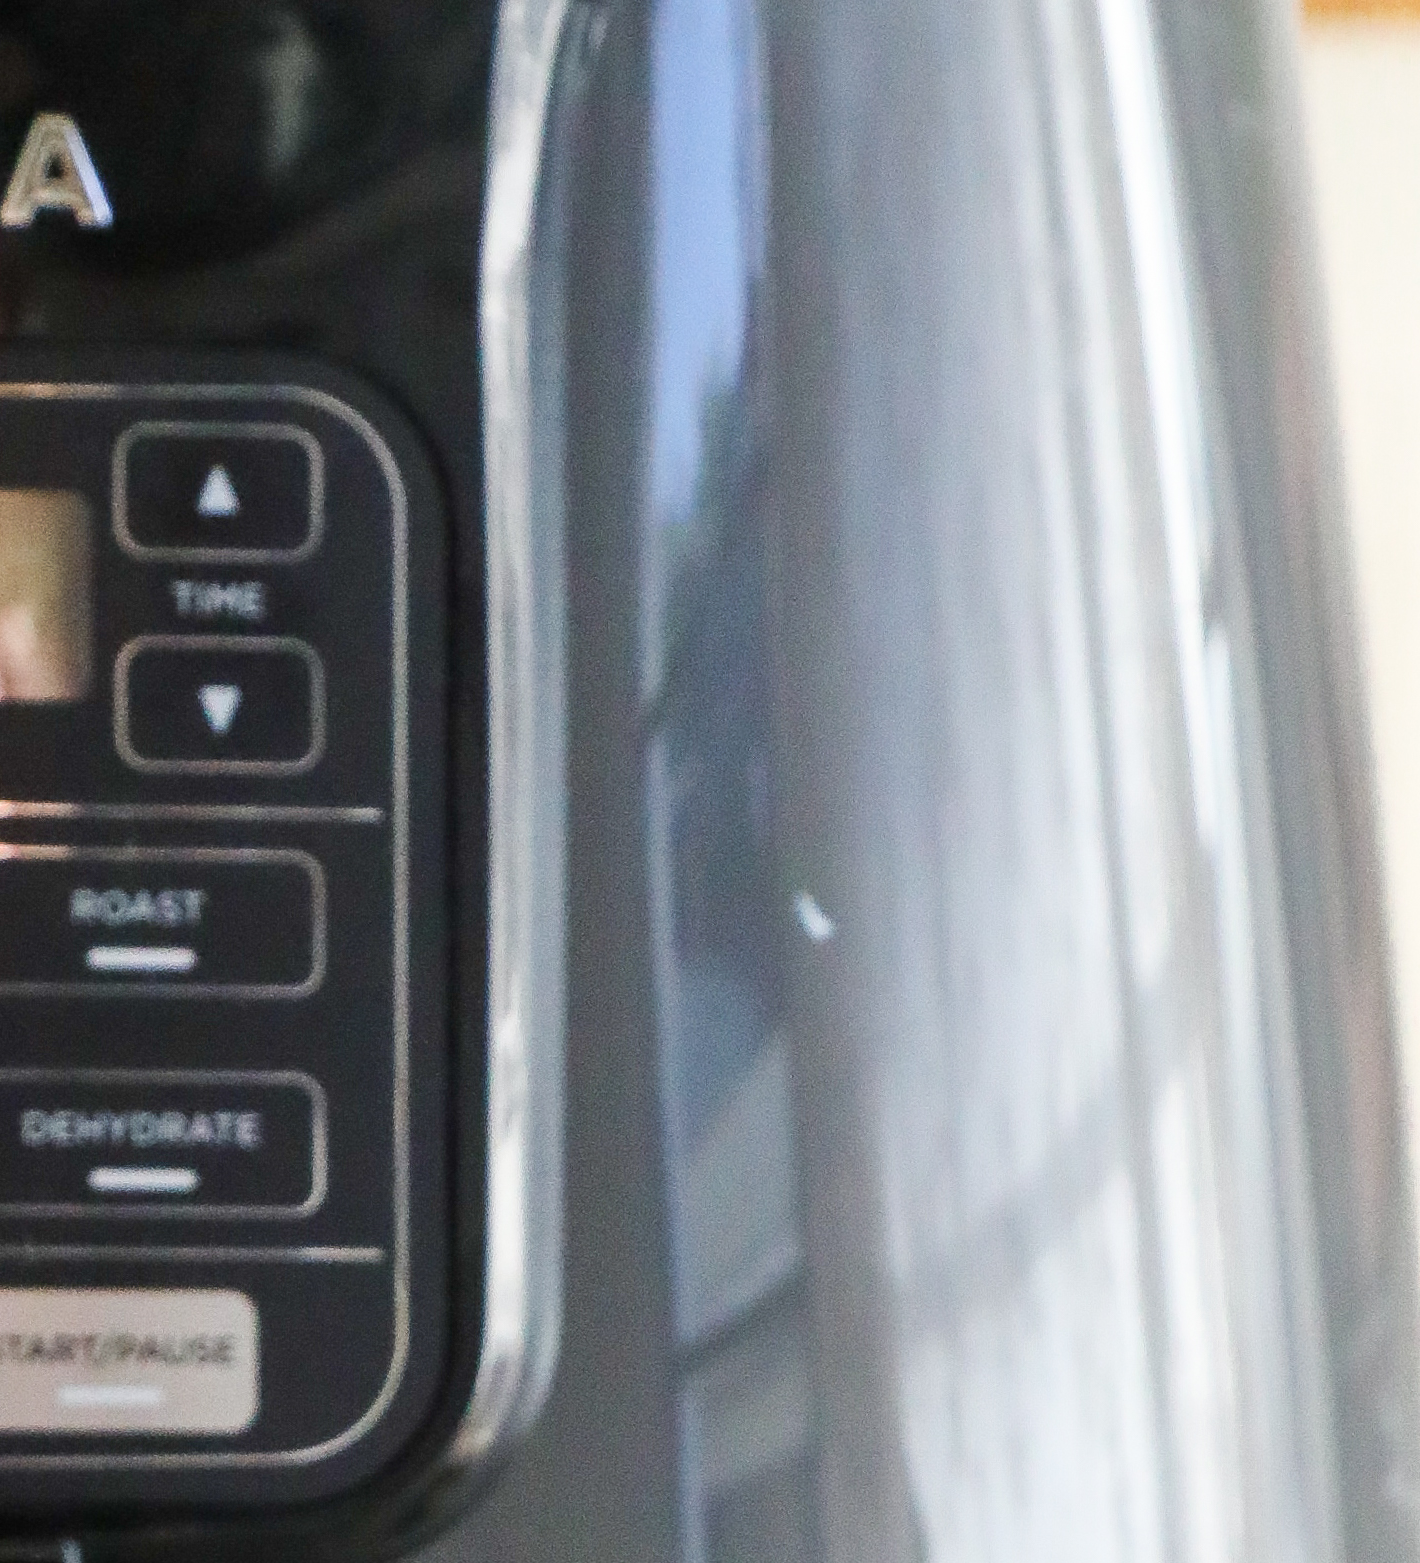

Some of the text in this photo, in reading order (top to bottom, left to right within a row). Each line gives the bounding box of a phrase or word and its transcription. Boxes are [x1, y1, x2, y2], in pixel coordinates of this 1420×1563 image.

[172, 578, 265, 620] TIME
[68, 886, 206, 927] ROAST
[19, 1108, 263, 1150] DEHYDRATE
